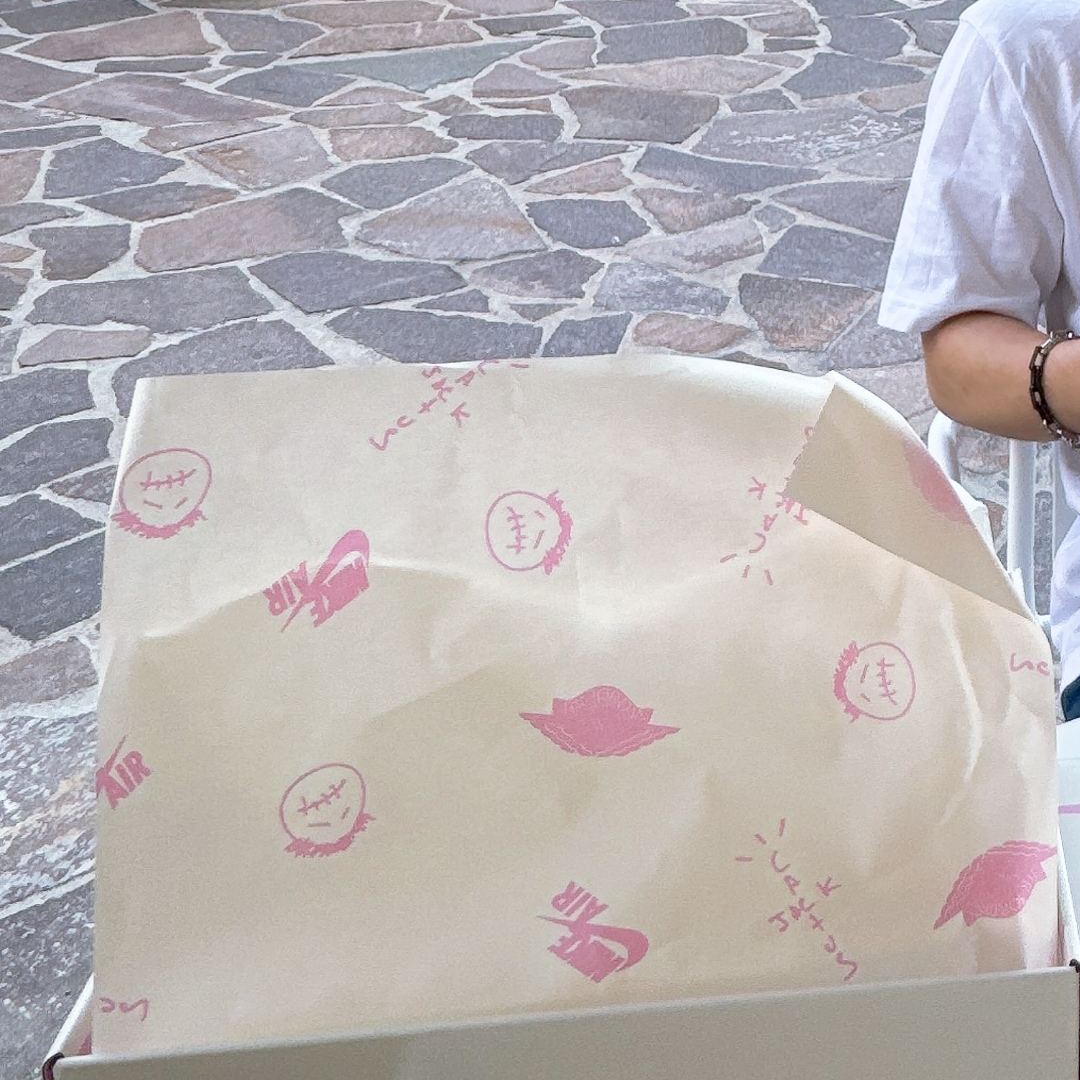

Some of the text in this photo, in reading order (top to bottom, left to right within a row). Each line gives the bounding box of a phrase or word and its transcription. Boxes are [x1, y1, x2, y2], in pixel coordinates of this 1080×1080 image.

[263, 560, 308, 616] AIR
[104, 750, 151, 811] AIR
[551, 880, 608, 921] AIR
